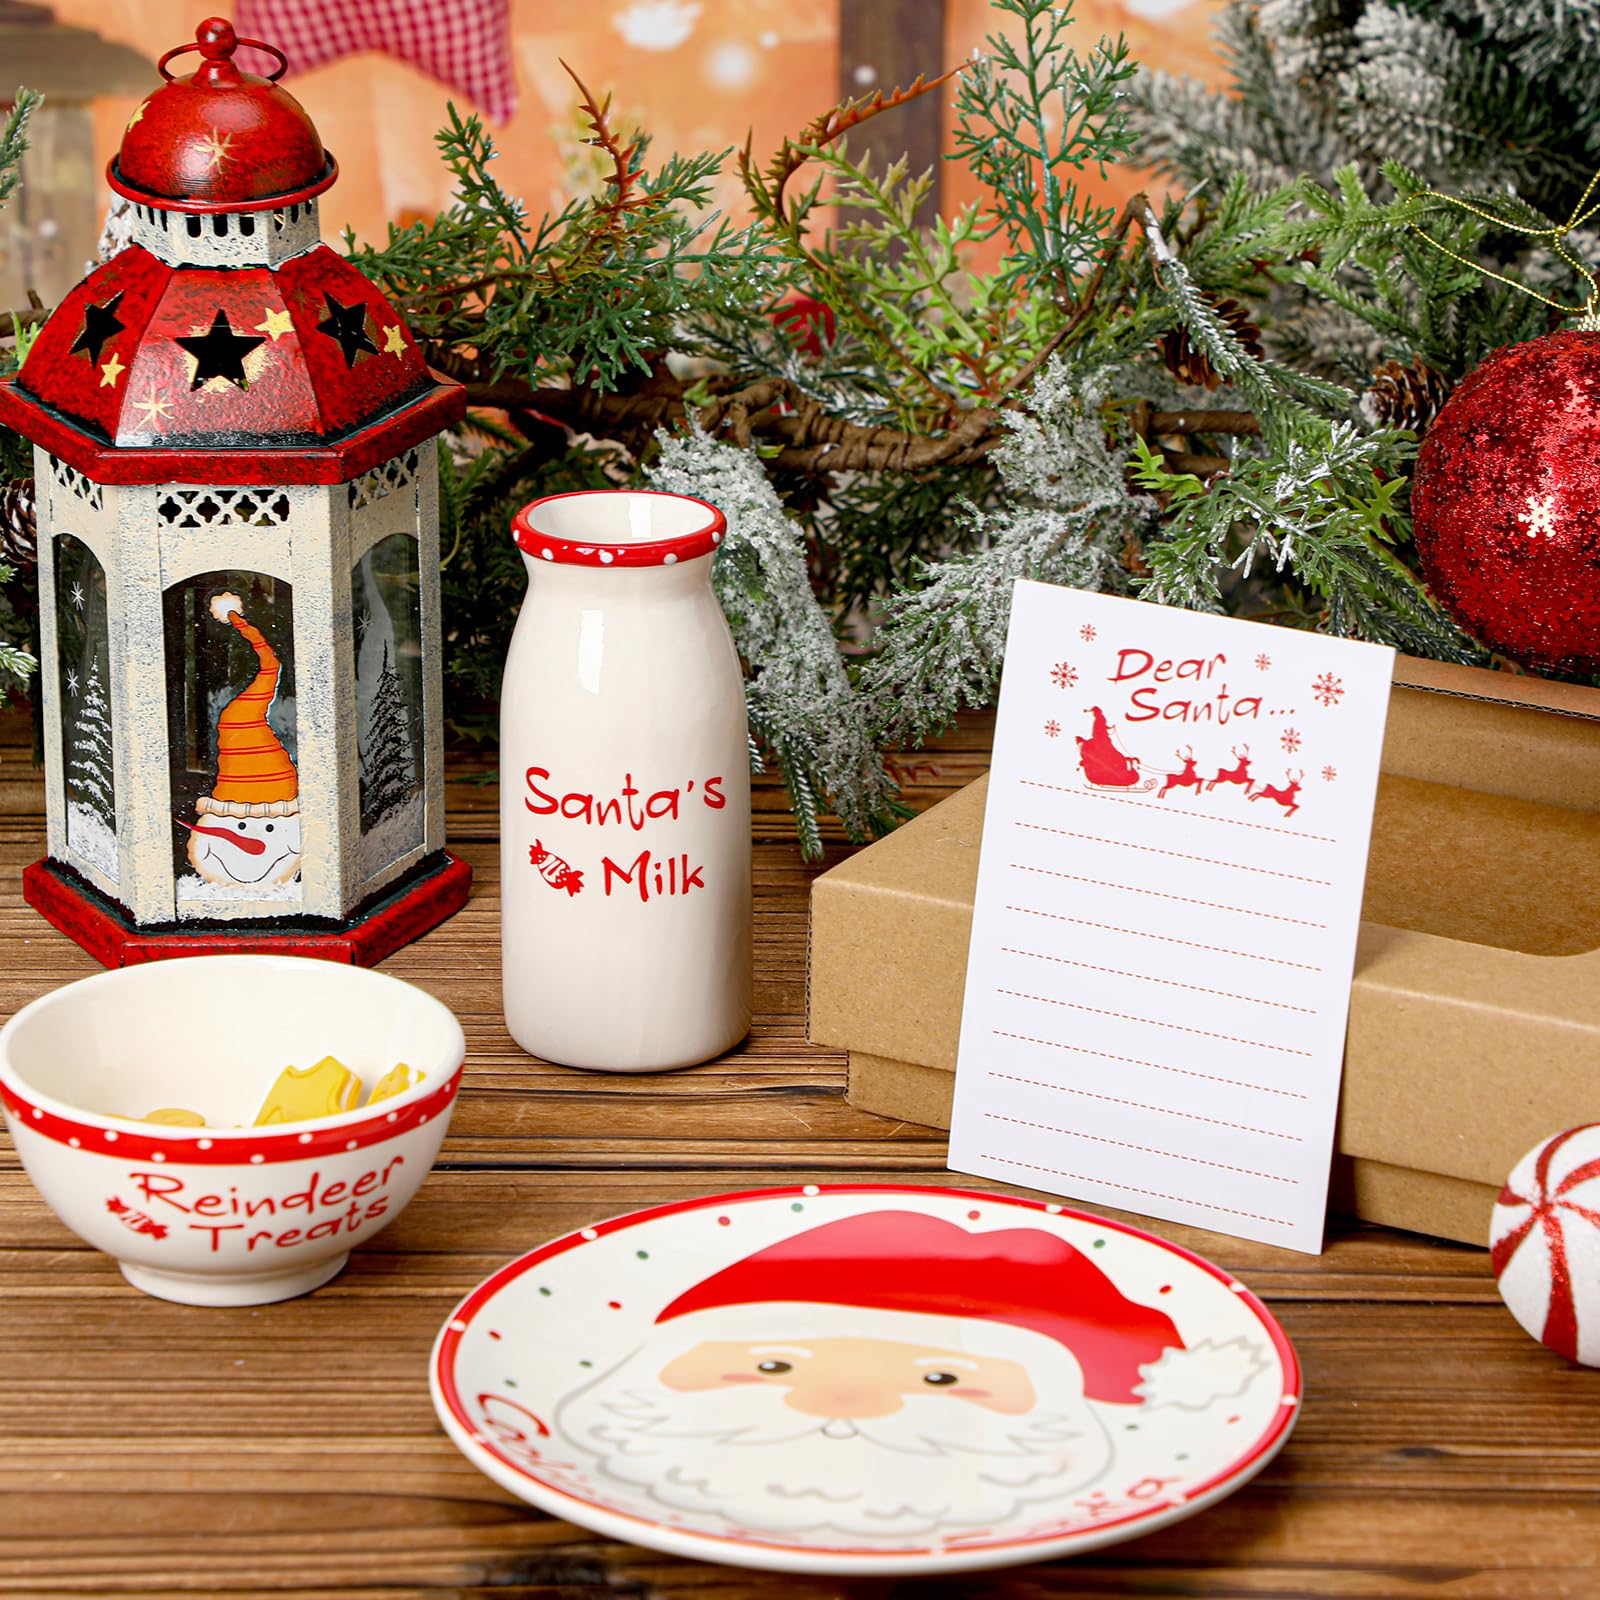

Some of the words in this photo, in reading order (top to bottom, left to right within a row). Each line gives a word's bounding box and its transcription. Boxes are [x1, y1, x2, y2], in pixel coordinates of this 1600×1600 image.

[1106, 648, 1227, 685] Dear
[1124, 683, 1296, 726] Santa...
[524, 766, 727, 832] Santa's
[600, 849, 706, 904] Milk
[128, 1154, 405, 1219] Reindeer
[188, 1195, 390, 1253] Treats
